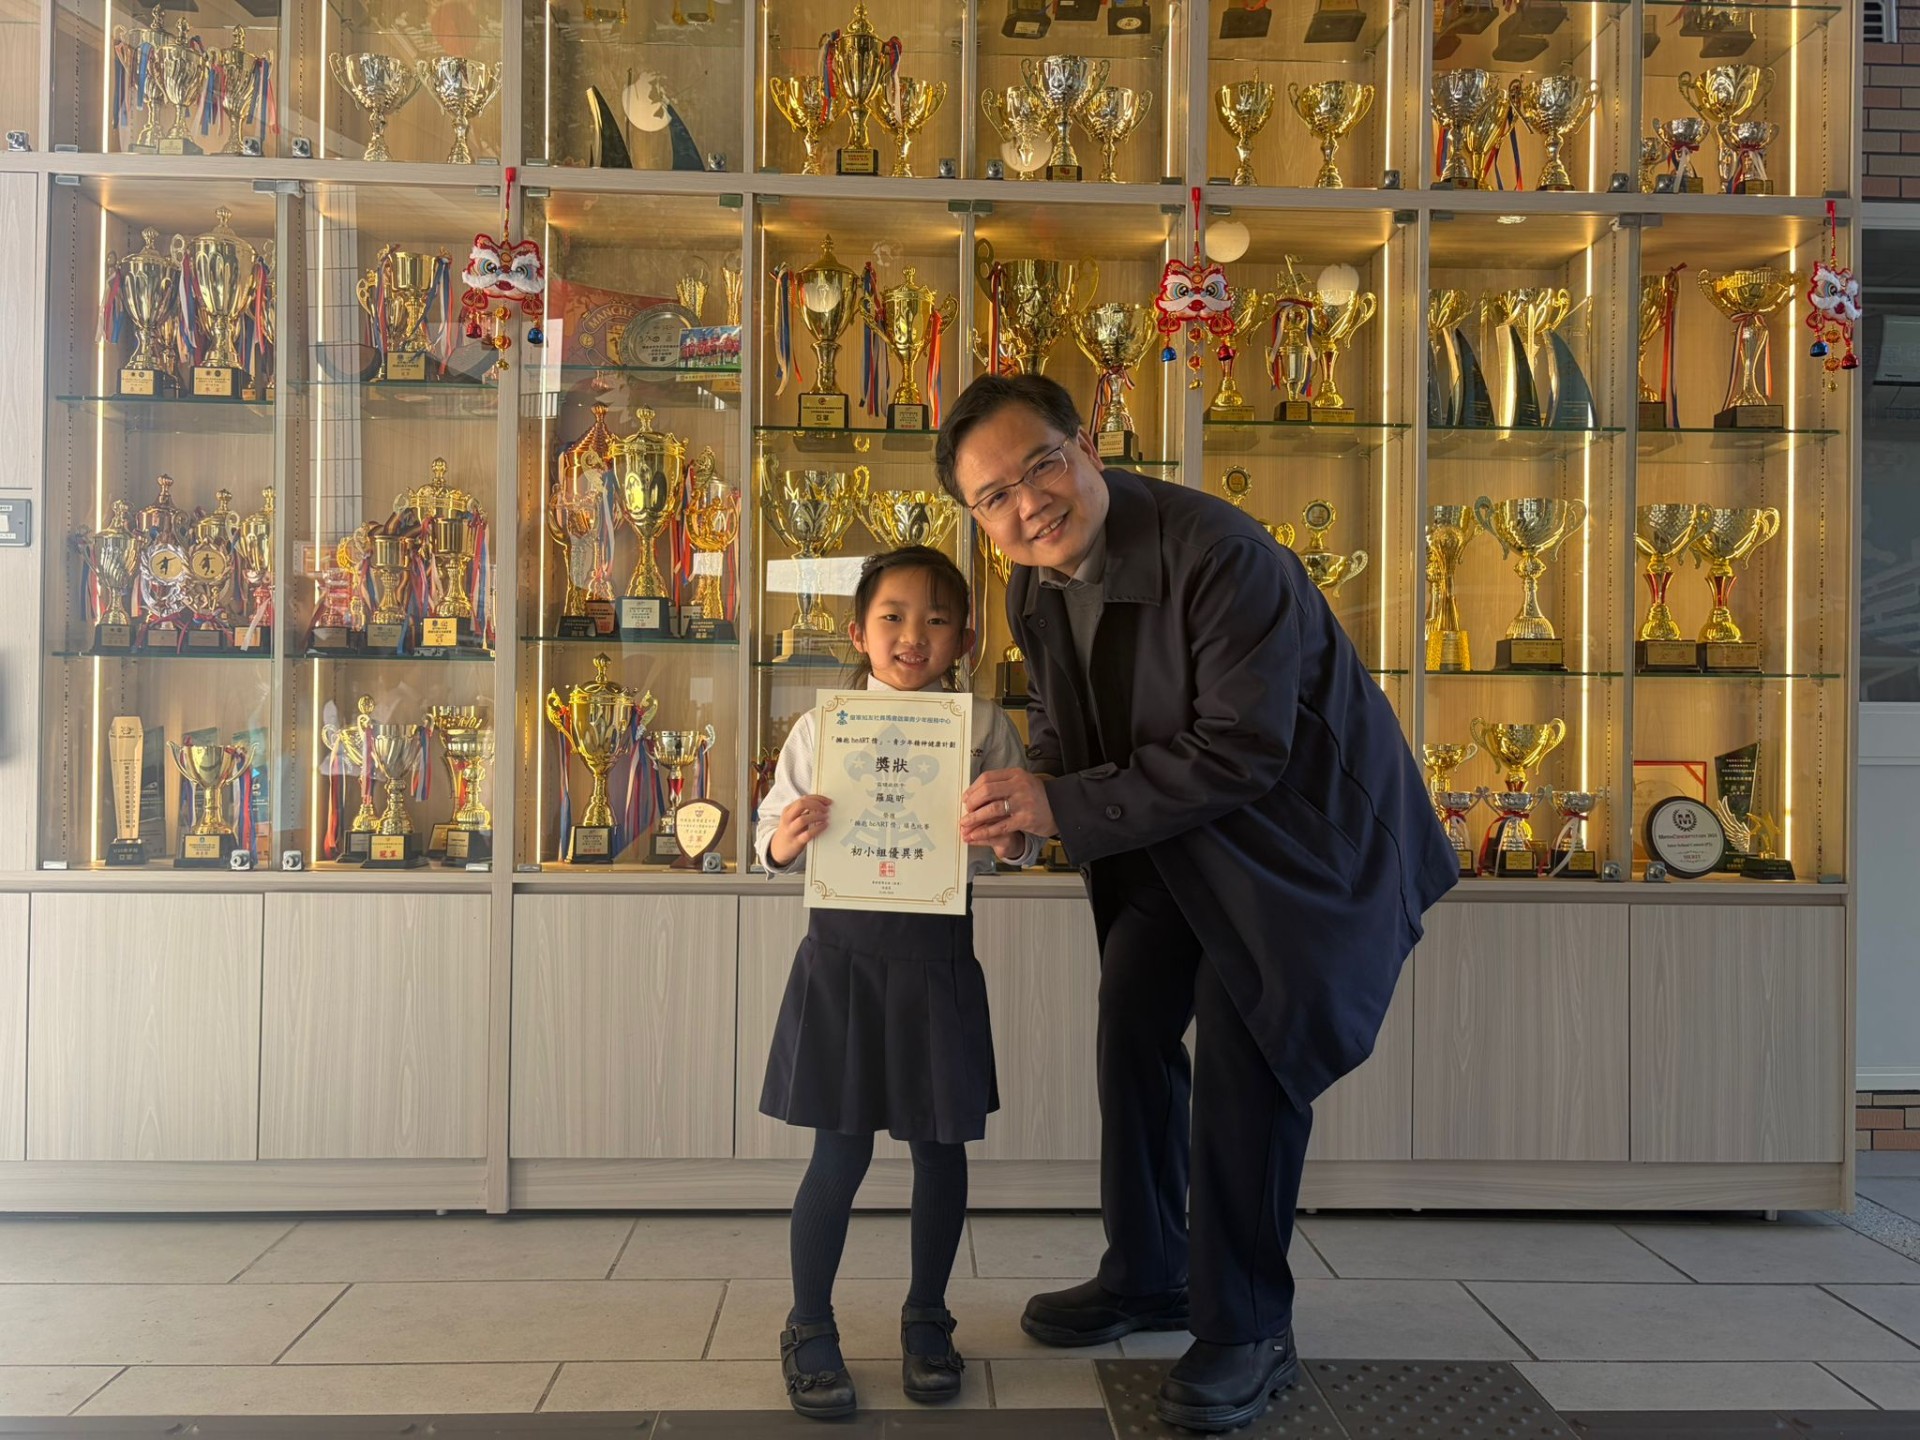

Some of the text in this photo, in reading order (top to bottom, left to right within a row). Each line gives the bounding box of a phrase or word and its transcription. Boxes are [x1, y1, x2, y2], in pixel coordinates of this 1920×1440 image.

[588, 306, 635, 329] MANCHE
[875, 756, 909, 773] 獎狀
[850, 845, 925, 860] 初小組優異獎
